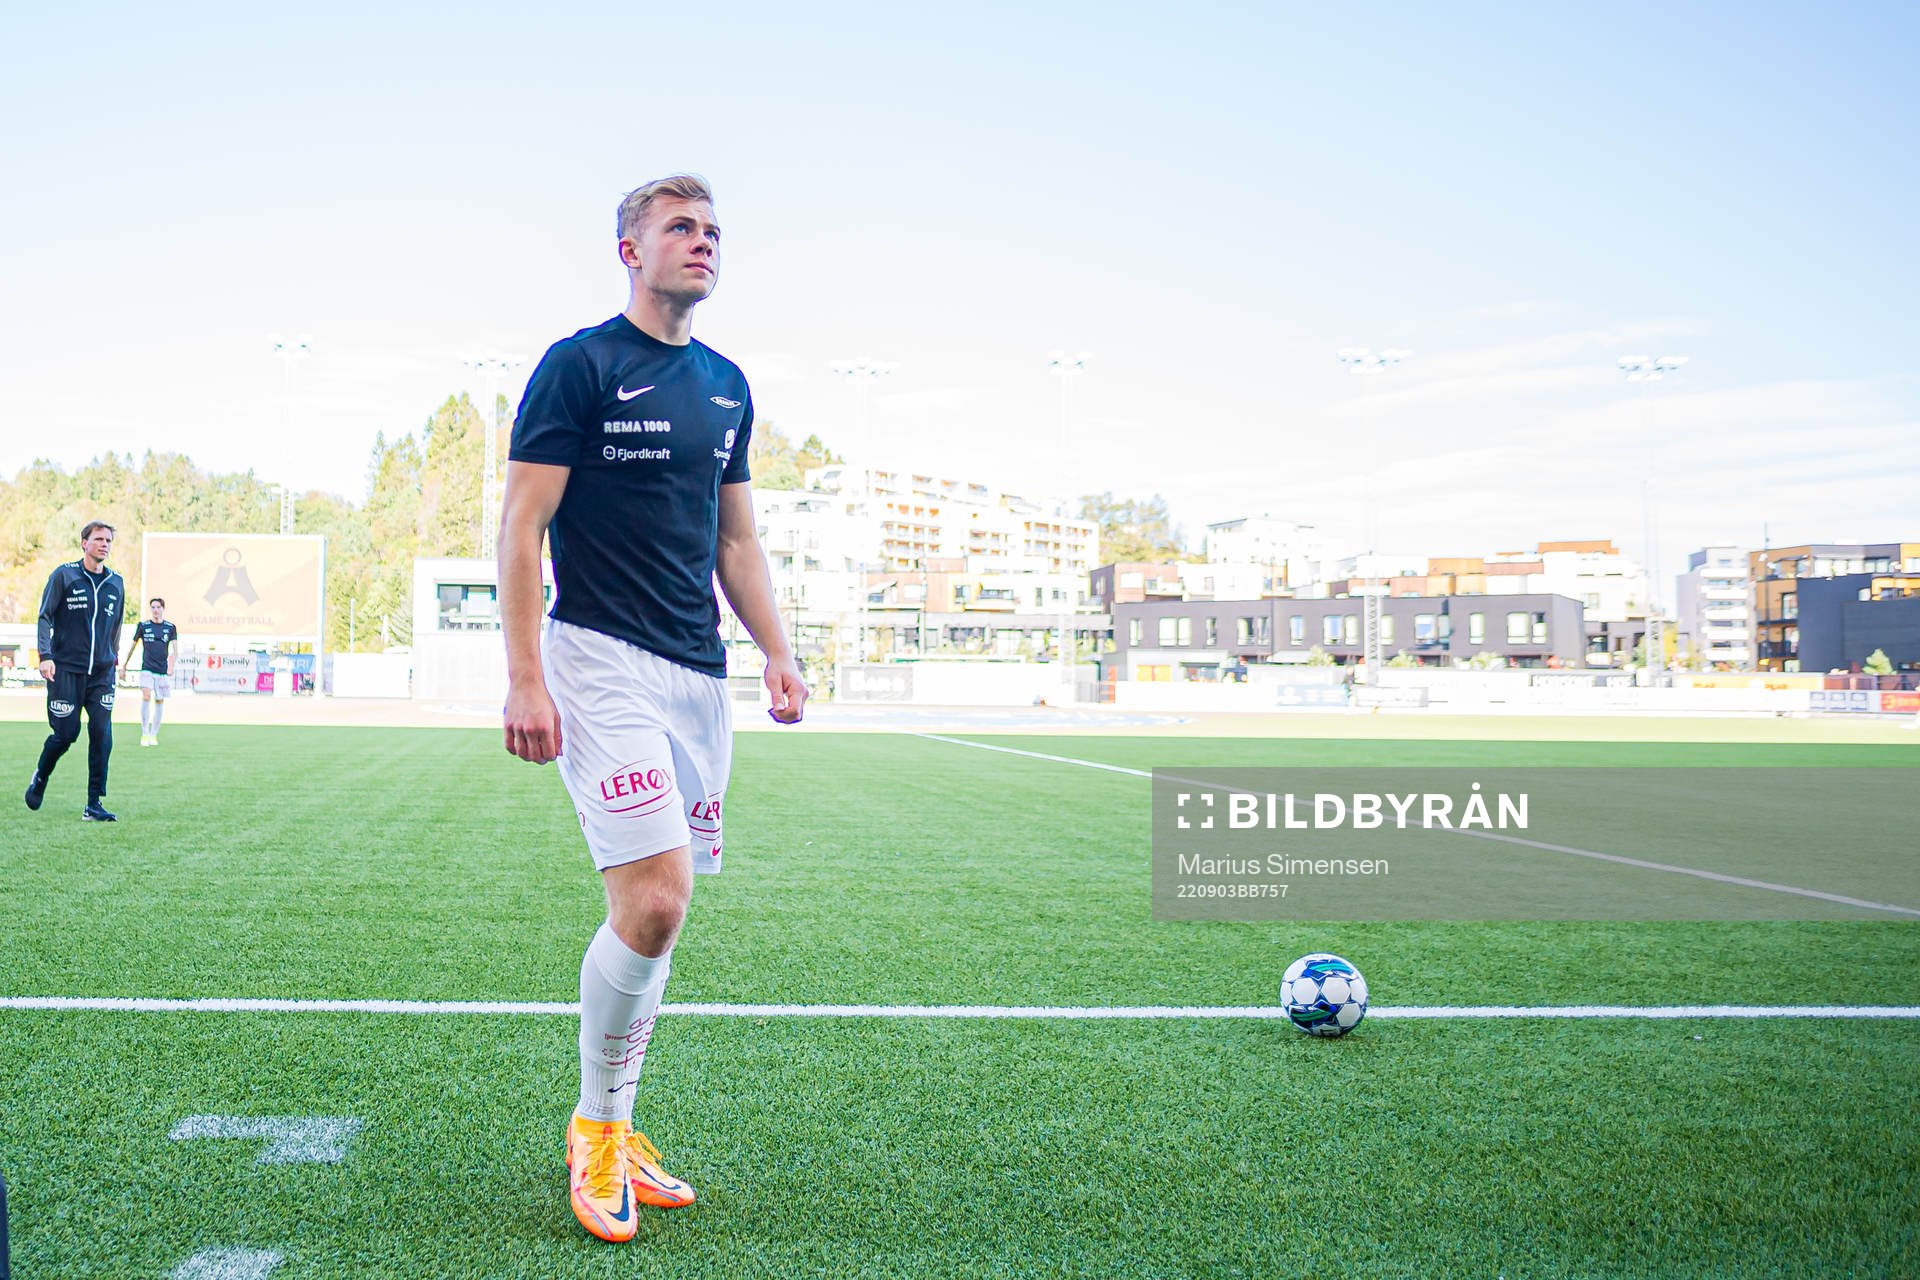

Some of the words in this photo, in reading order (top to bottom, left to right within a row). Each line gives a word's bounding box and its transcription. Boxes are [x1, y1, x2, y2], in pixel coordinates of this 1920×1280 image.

[604, 421, 642, 433] REMA
[643, 420, 671, 432] 1000
[617, 448, 671, 461] Fjordkraft
[187, 613, 224, 625] ÅSANE
[226, 615, 274, 626] FOTBALL
[178, 656, 201, 666] amily
[222, 656, 250, 668] Family
